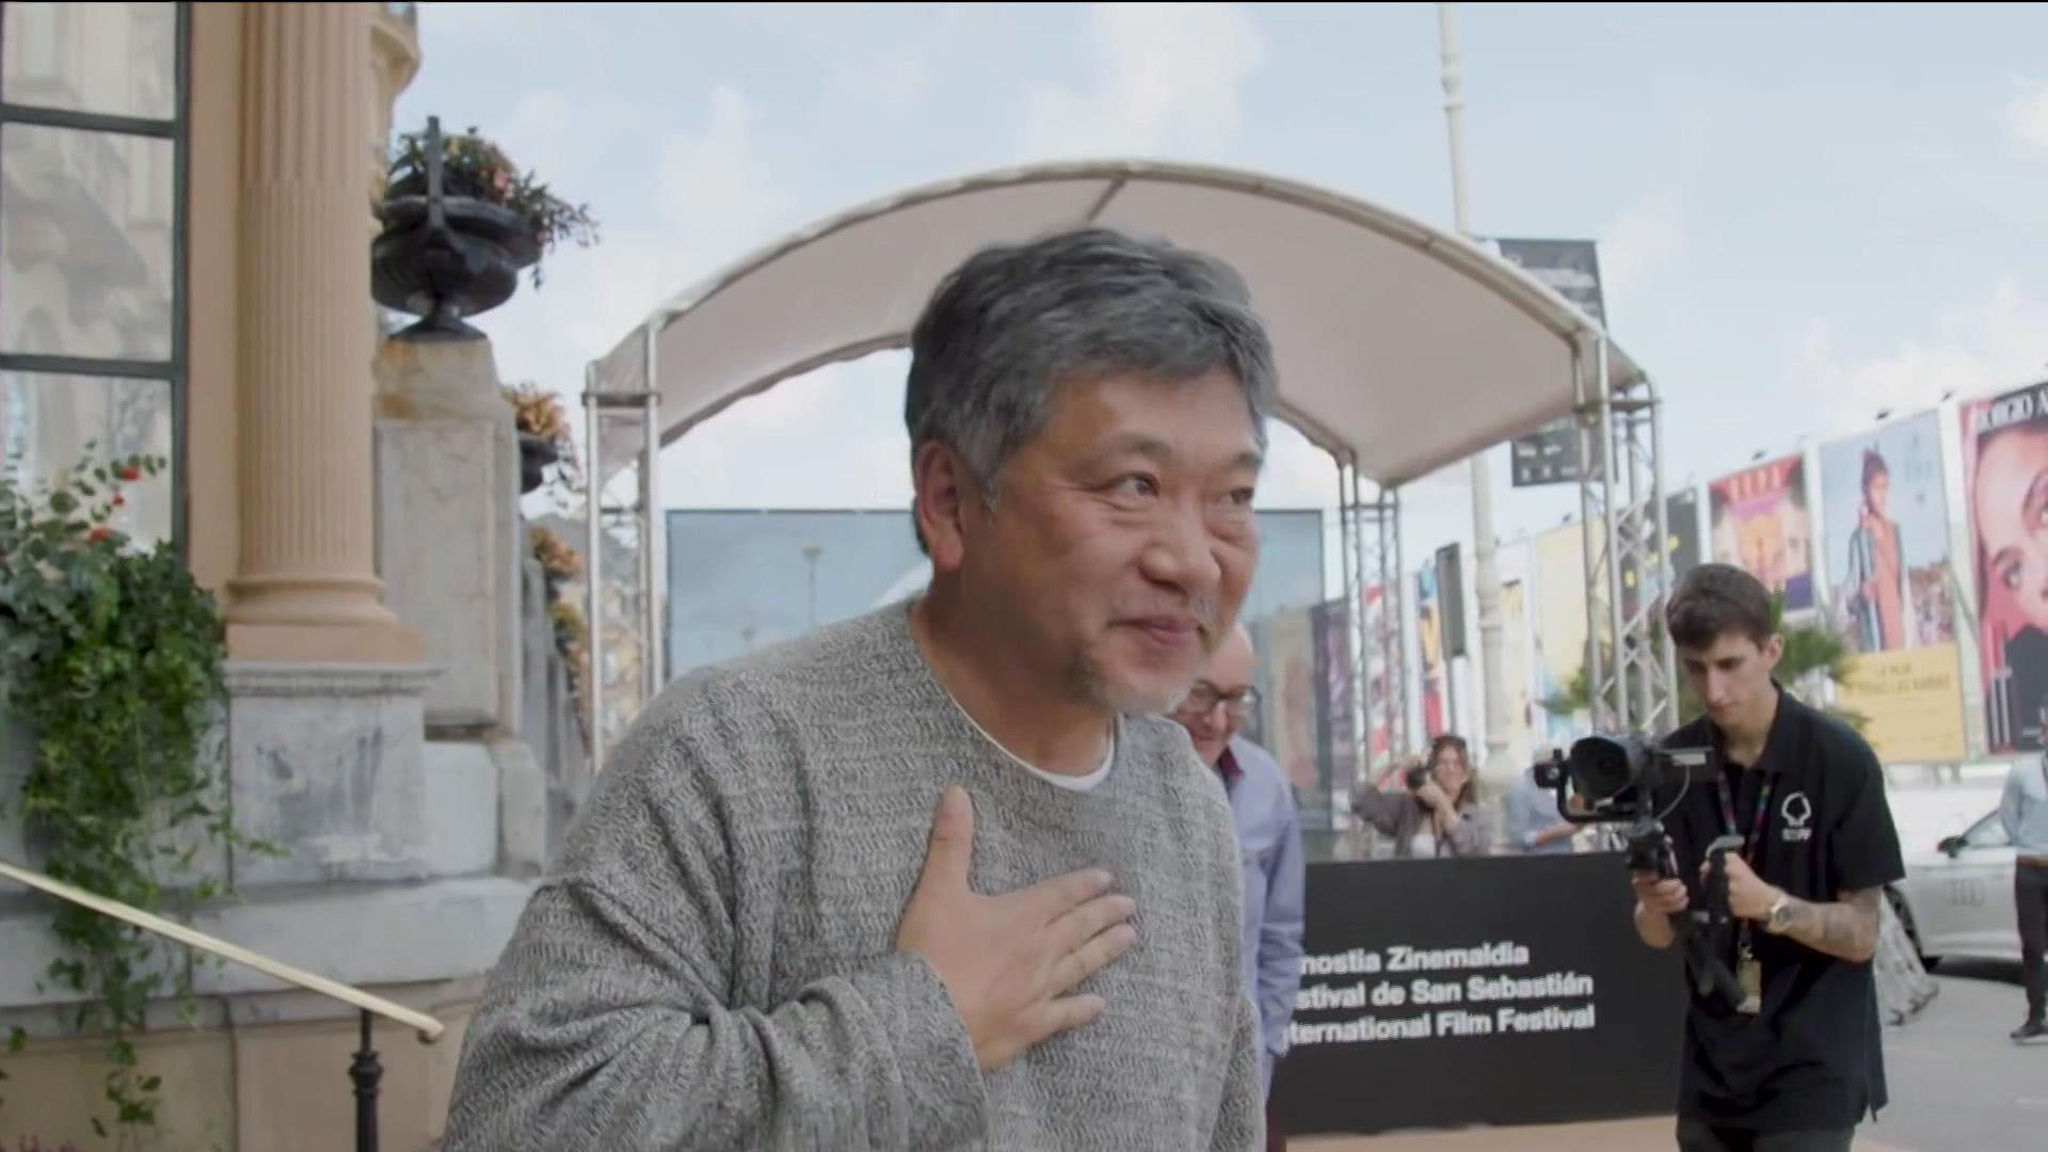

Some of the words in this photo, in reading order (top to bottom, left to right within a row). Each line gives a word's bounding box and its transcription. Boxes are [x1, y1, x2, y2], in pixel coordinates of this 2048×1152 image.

[1387, 941, 1530, 972] Zinemaldia
[1371, 980, 1407, 1007] de
[1411, 978, 1462, 1004] San
[1467, 970, 1594, 1001] Sebastián
[1437, 1010, 1492, 1037] Film
[1497, 1003, 1596, 1033] Festival
